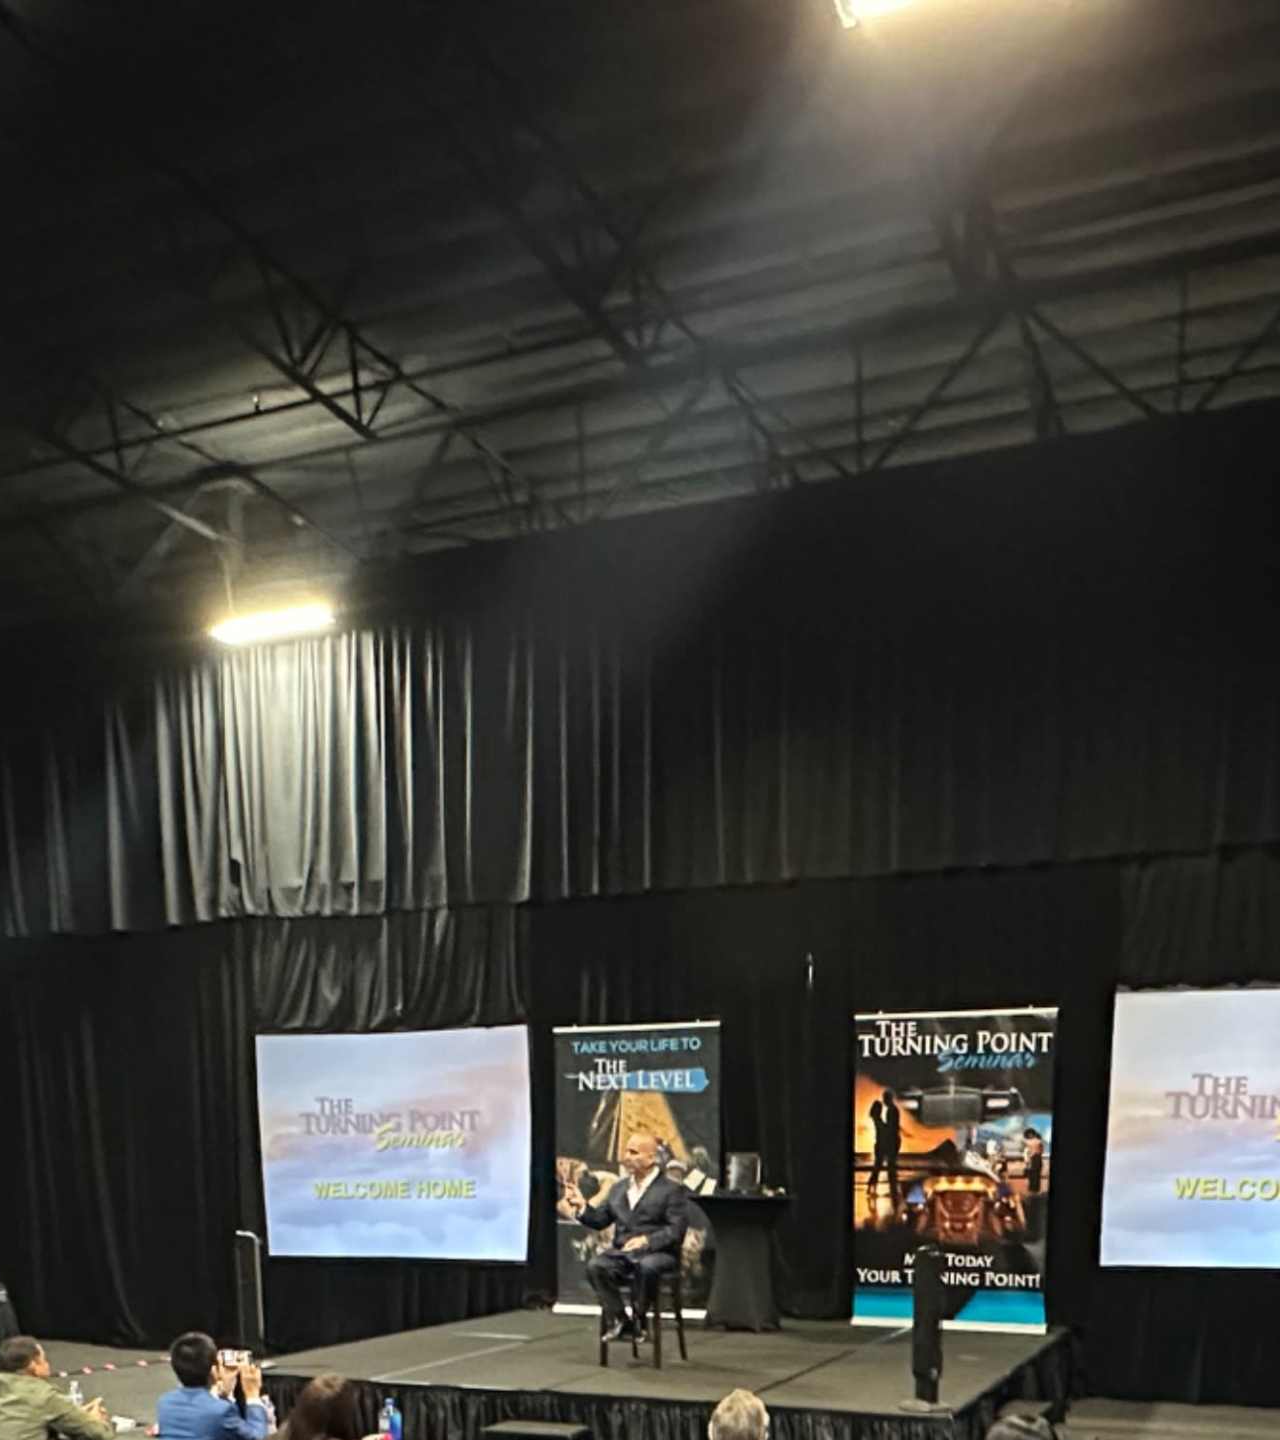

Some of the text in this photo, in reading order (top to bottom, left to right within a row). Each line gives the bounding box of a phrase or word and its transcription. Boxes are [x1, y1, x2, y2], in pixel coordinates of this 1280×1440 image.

[876, 1021, 917, 1038] THE
[572, 1037, 701, 1054] TAKE YOUR LIFE TO
[858, 1031, 1053, 1057] TURNING POINT
[594, 1058, 627, 1073] THE
[936, 1047, 1038, 1072] Seminar
[578, 1069, 695, 1091] NEXT LEVEL
[1192, 1074, 1248, 1095] THE
[315, 1096, 353, 1116] THE
[299, 1110, 480, 1135] TURNING POINT
[313, 1179, 477, 1200] WELCOME HOME
[945, 1253, 994, 1268] TODAY
[856, 1268, 902, 1284] YOUR
[984, 1272, 1041, 1288] POINT!
